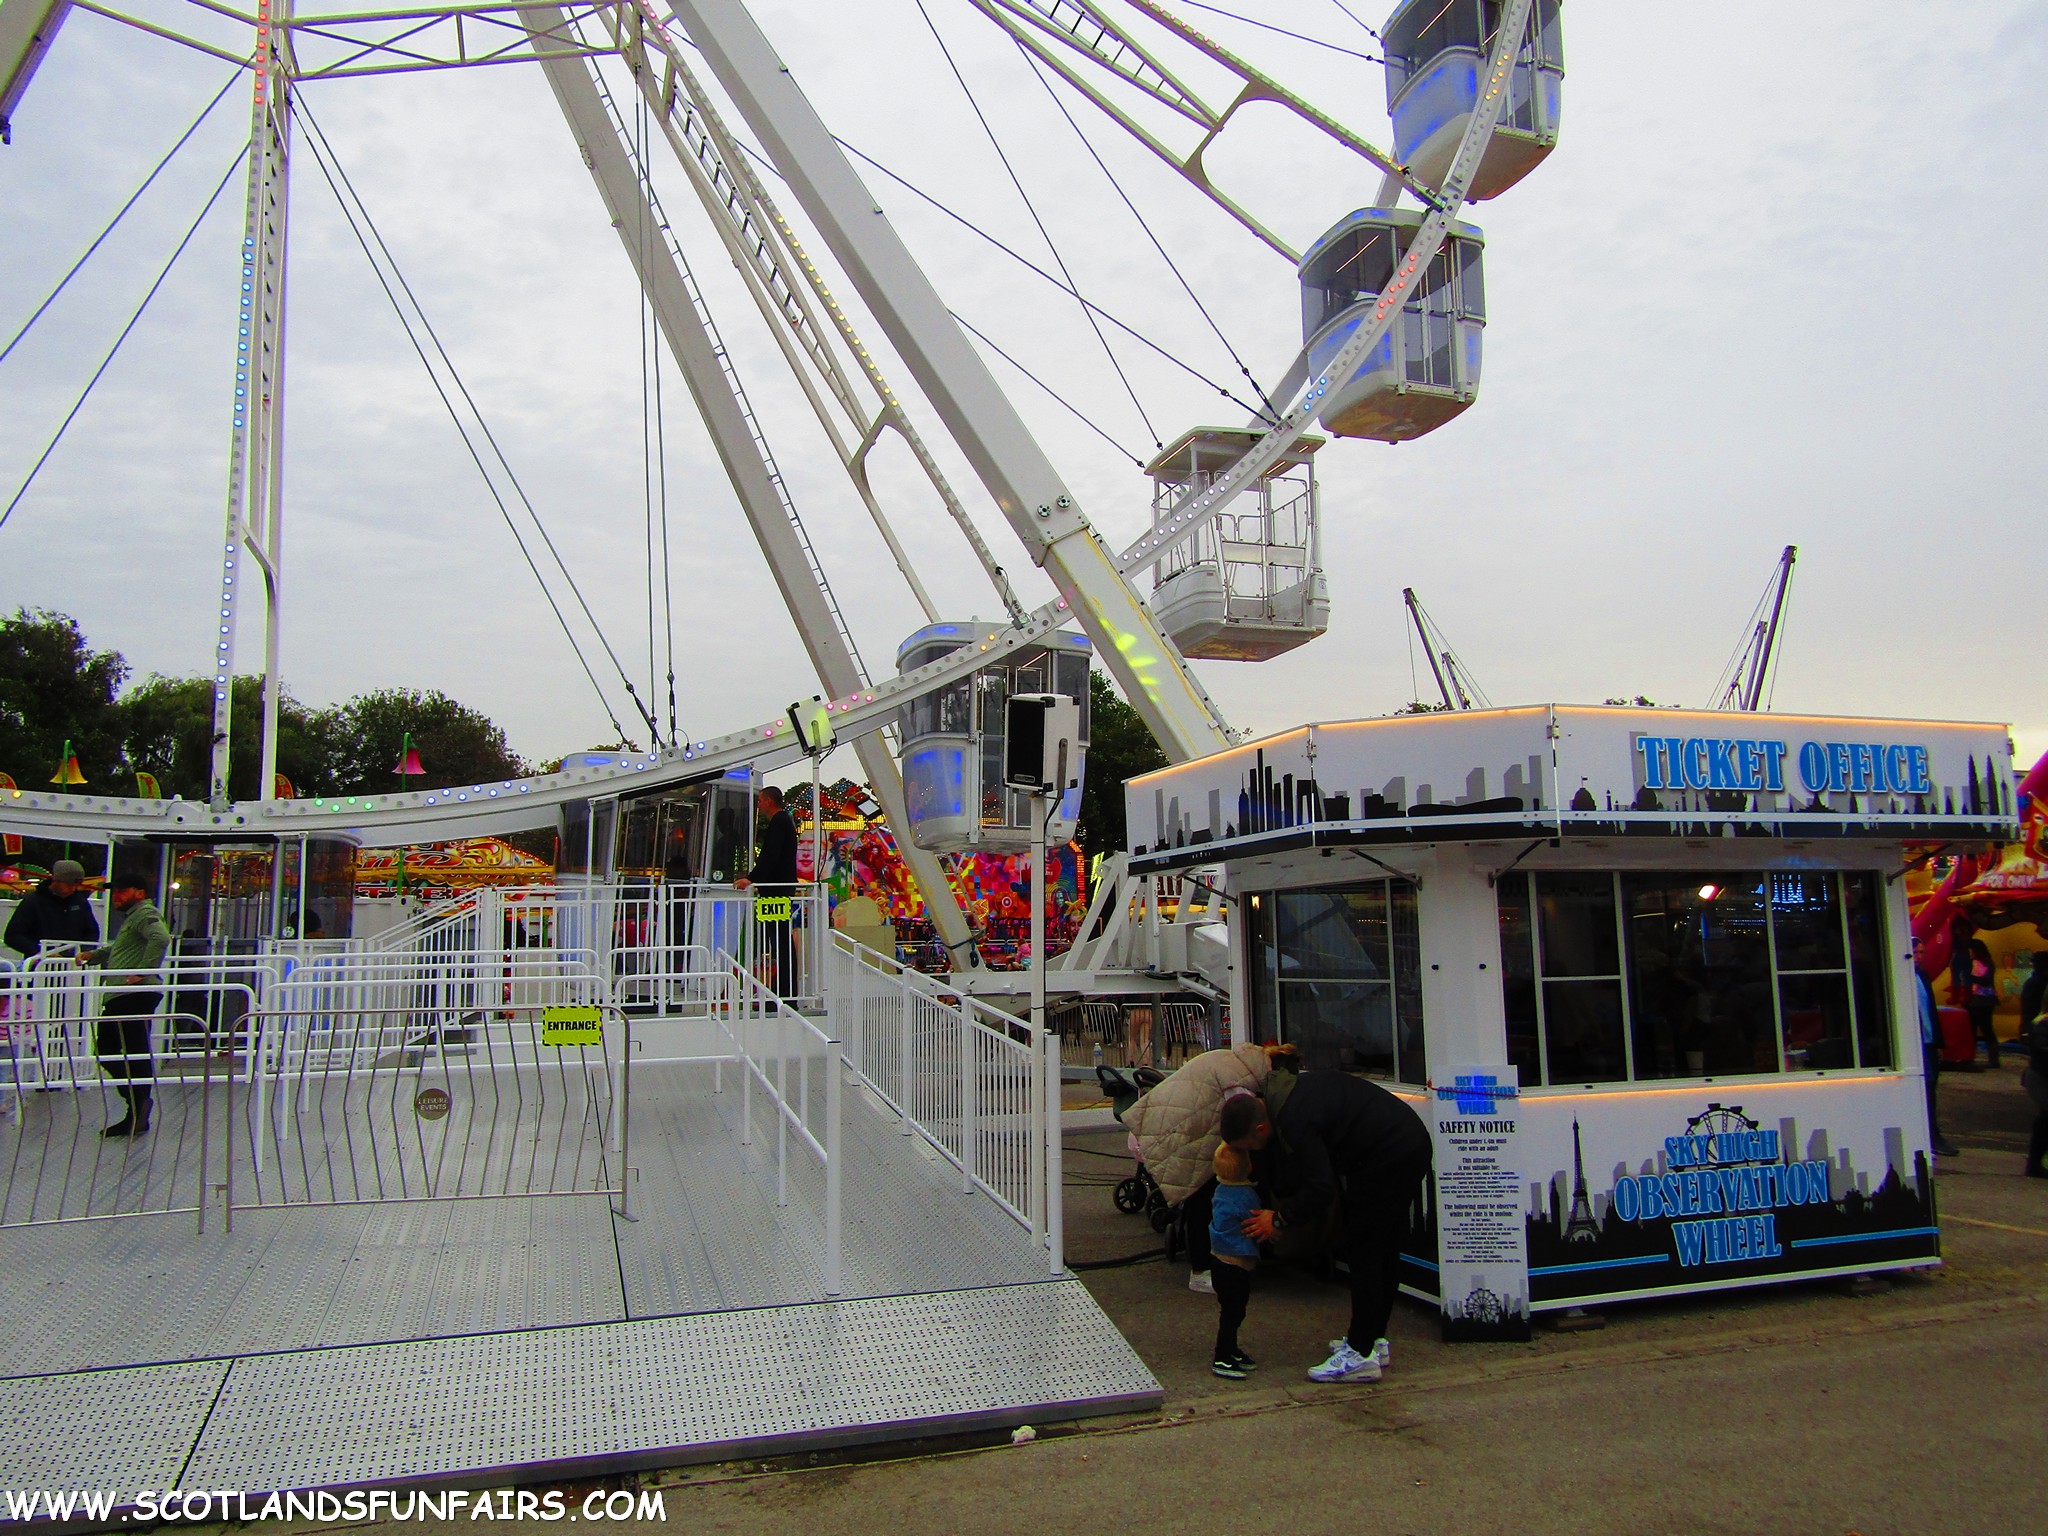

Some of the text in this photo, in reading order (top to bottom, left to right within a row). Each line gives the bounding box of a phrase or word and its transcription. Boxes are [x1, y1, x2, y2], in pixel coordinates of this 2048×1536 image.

[1635, 735, 1930, 794] TICKET OFFICE
[761, 903, 786, 915] EXIT
[547, 1020, 597, 1031] ENTRANCE
[1439, 1120, 1516, 1134] SAFETY NOTICE
[1664, 1130, 1779, 1168] SKY HIGH
[1613, 1160, 1829, 1222] OBSERVATION
[1671, 1214, 1783, 1268] WHEEL
